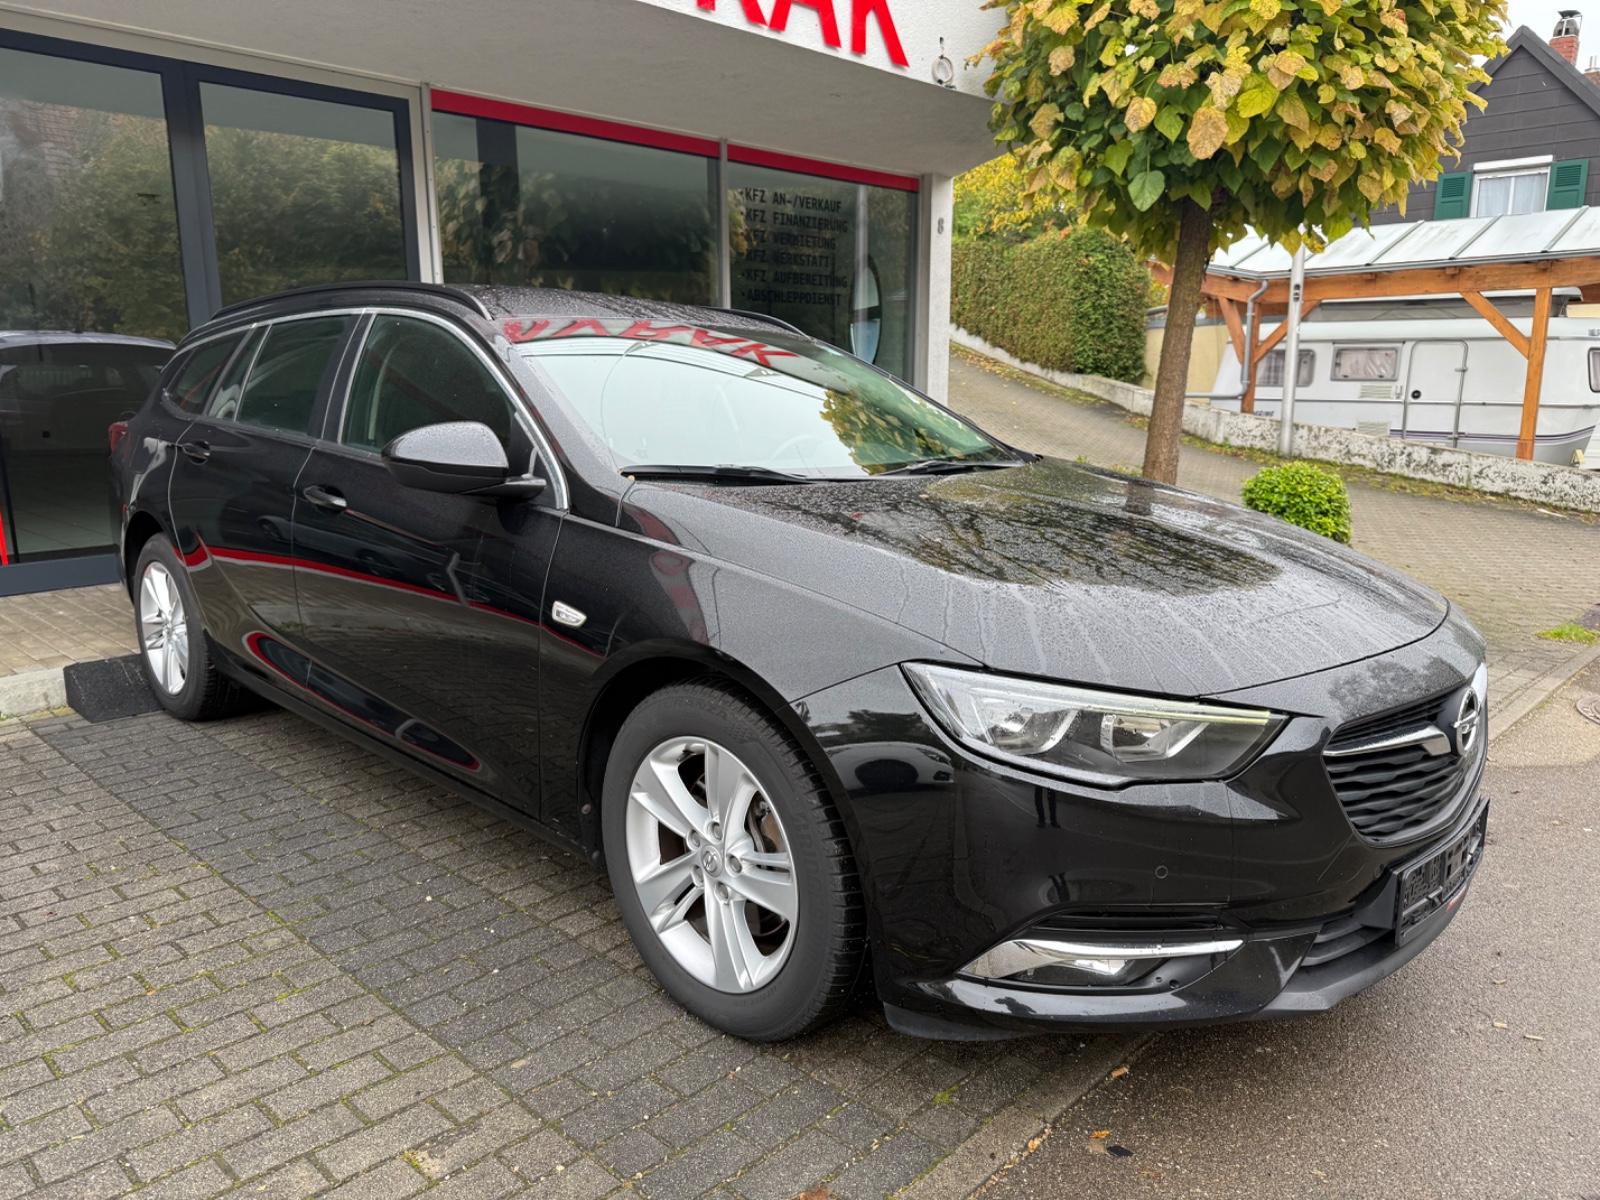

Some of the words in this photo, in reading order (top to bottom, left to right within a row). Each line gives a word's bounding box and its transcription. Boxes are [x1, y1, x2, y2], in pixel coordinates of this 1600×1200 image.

[745, 187, 766, 203] KFZ
[772, 192, 842, 213] AN-/VERKAUF
[773, 212, 849, 233] FINANZIERUNG
